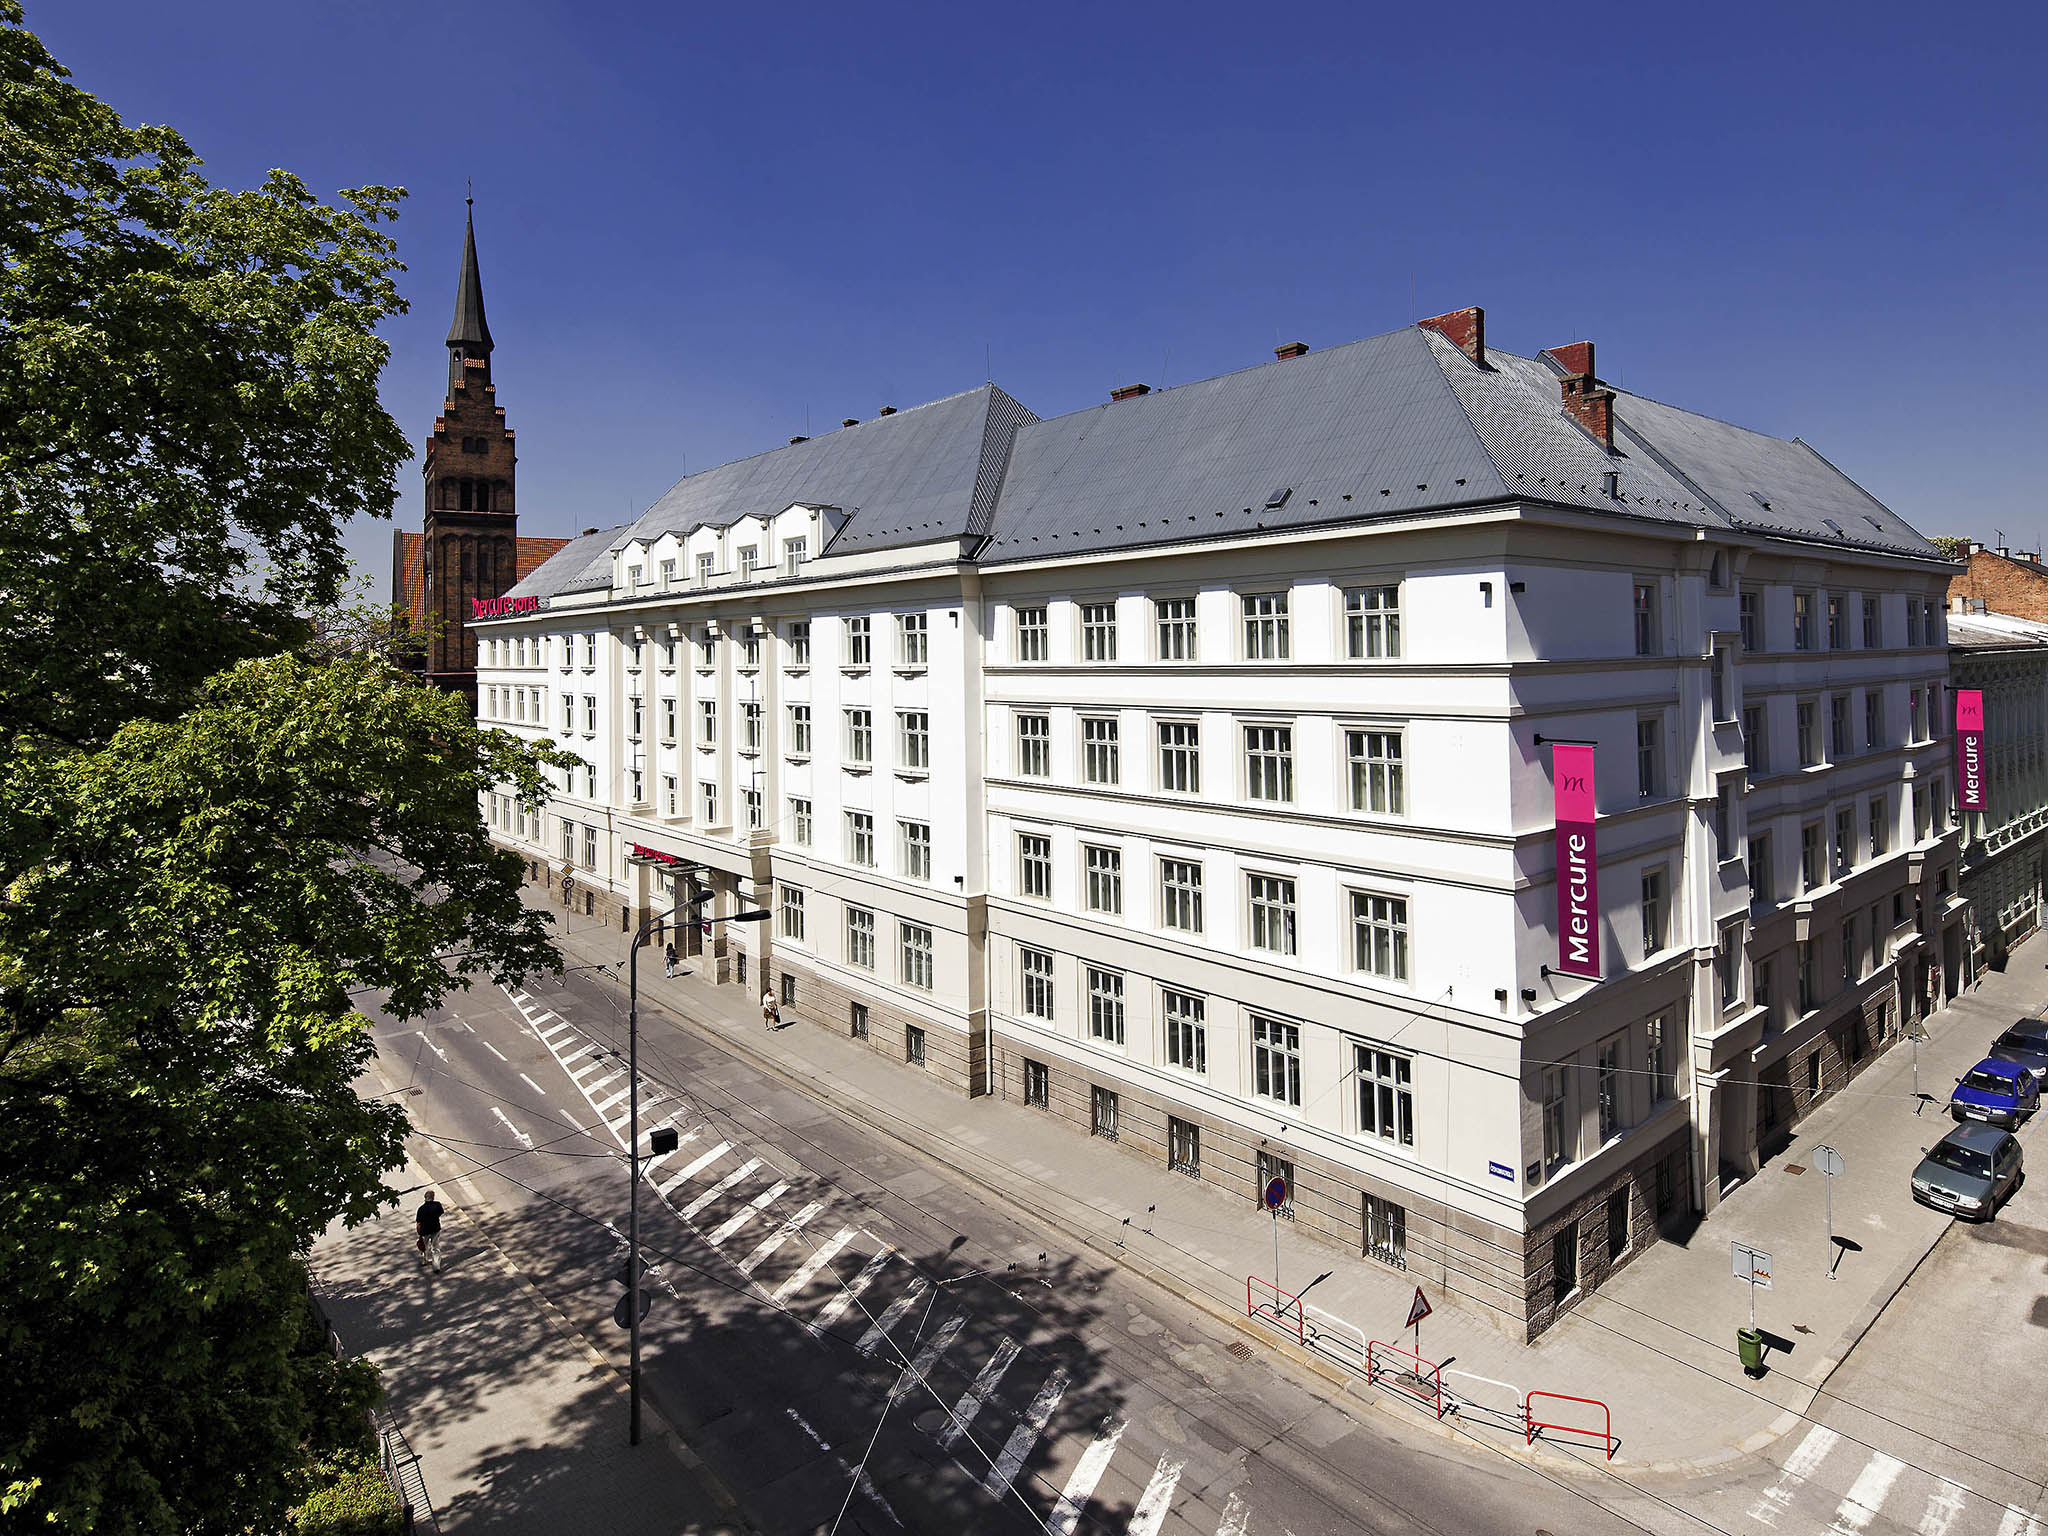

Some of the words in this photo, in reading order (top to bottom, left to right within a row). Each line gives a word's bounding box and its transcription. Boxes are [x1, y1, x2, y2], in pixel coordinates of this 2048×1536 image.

[513, 596, 537, 612] HOTEL
[1966, 736, 1979, 803] Mercure
[1569, 834, 1589, 963] Mercure
